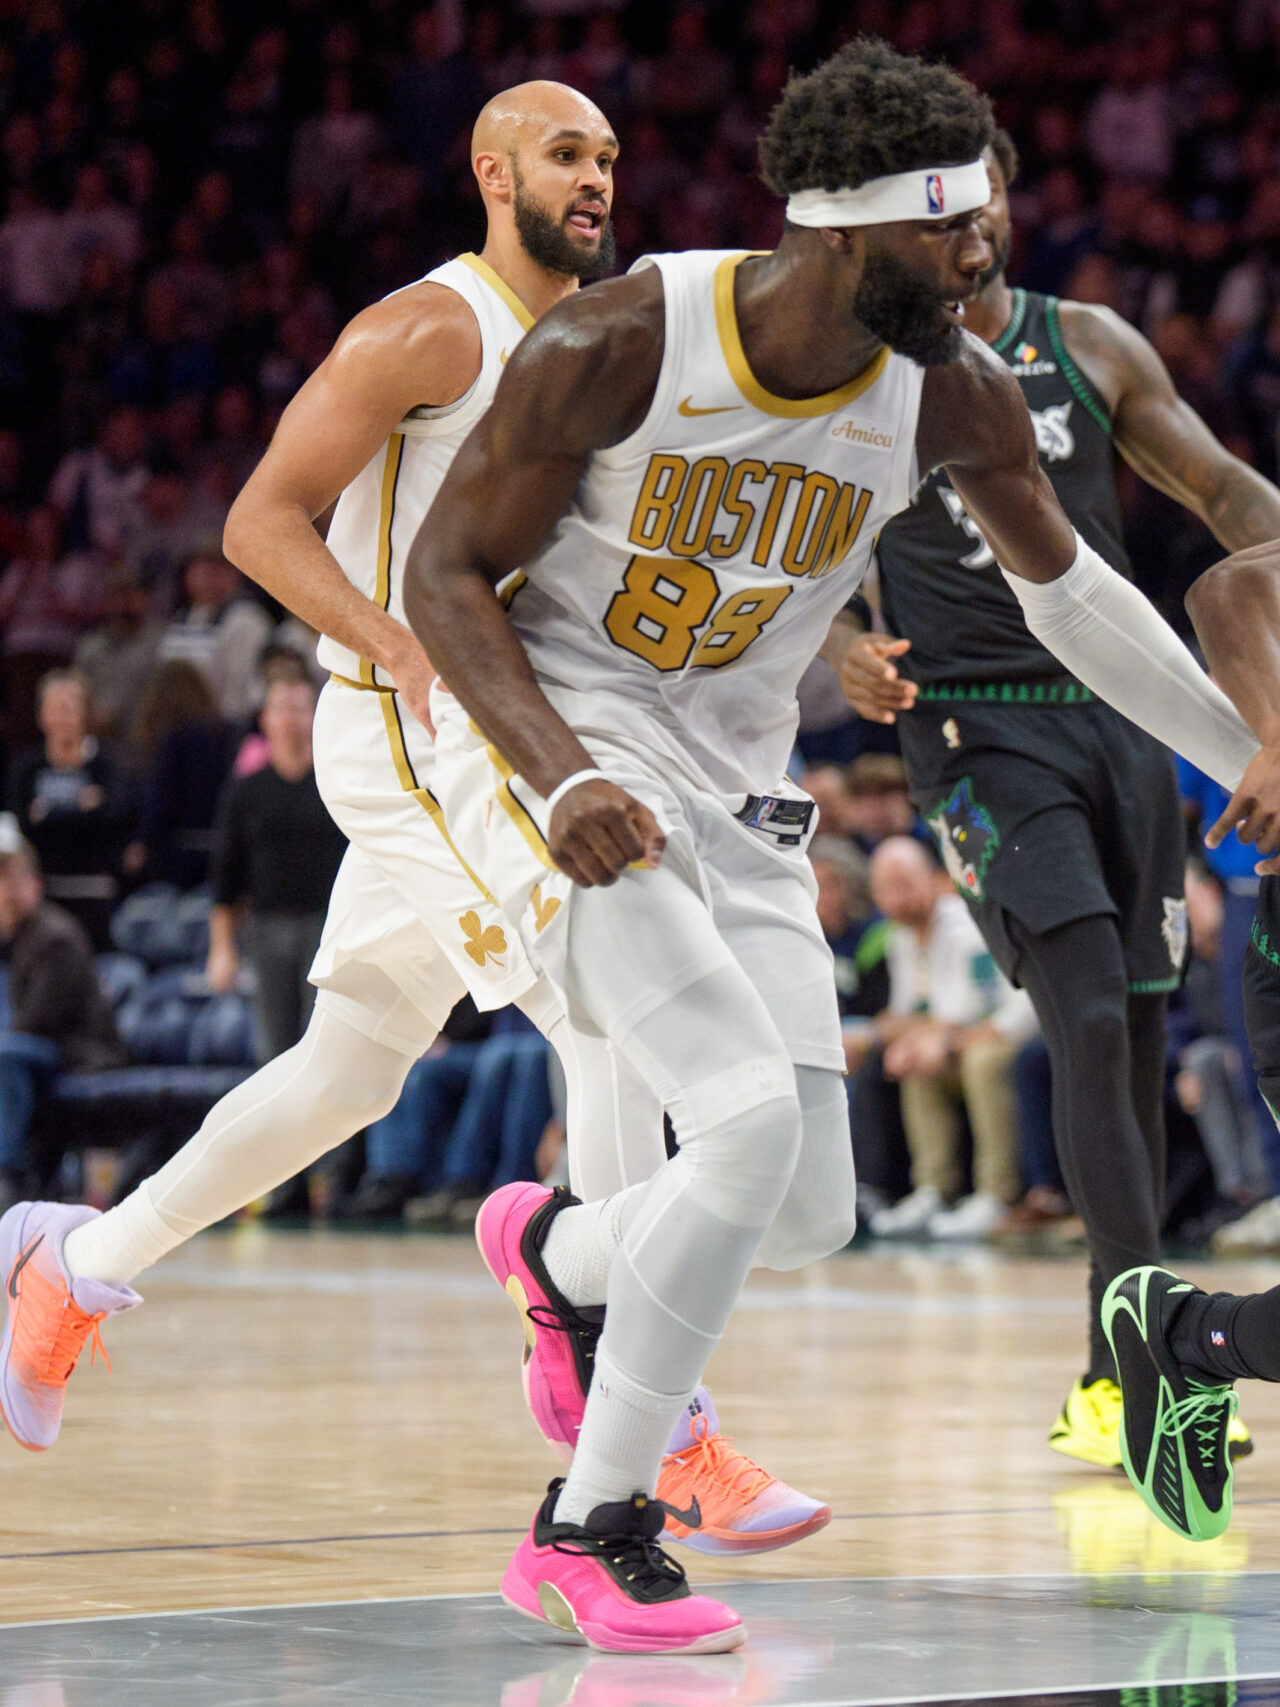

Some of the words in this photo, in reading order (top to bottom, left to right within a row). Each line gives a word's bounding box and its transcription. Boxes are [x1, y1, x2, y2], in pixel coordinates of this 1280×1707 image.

[831, 419, 894, 449] Amica
[627, 453, 874, 579] BOSTON
[603, 554, 794, 673] 88
